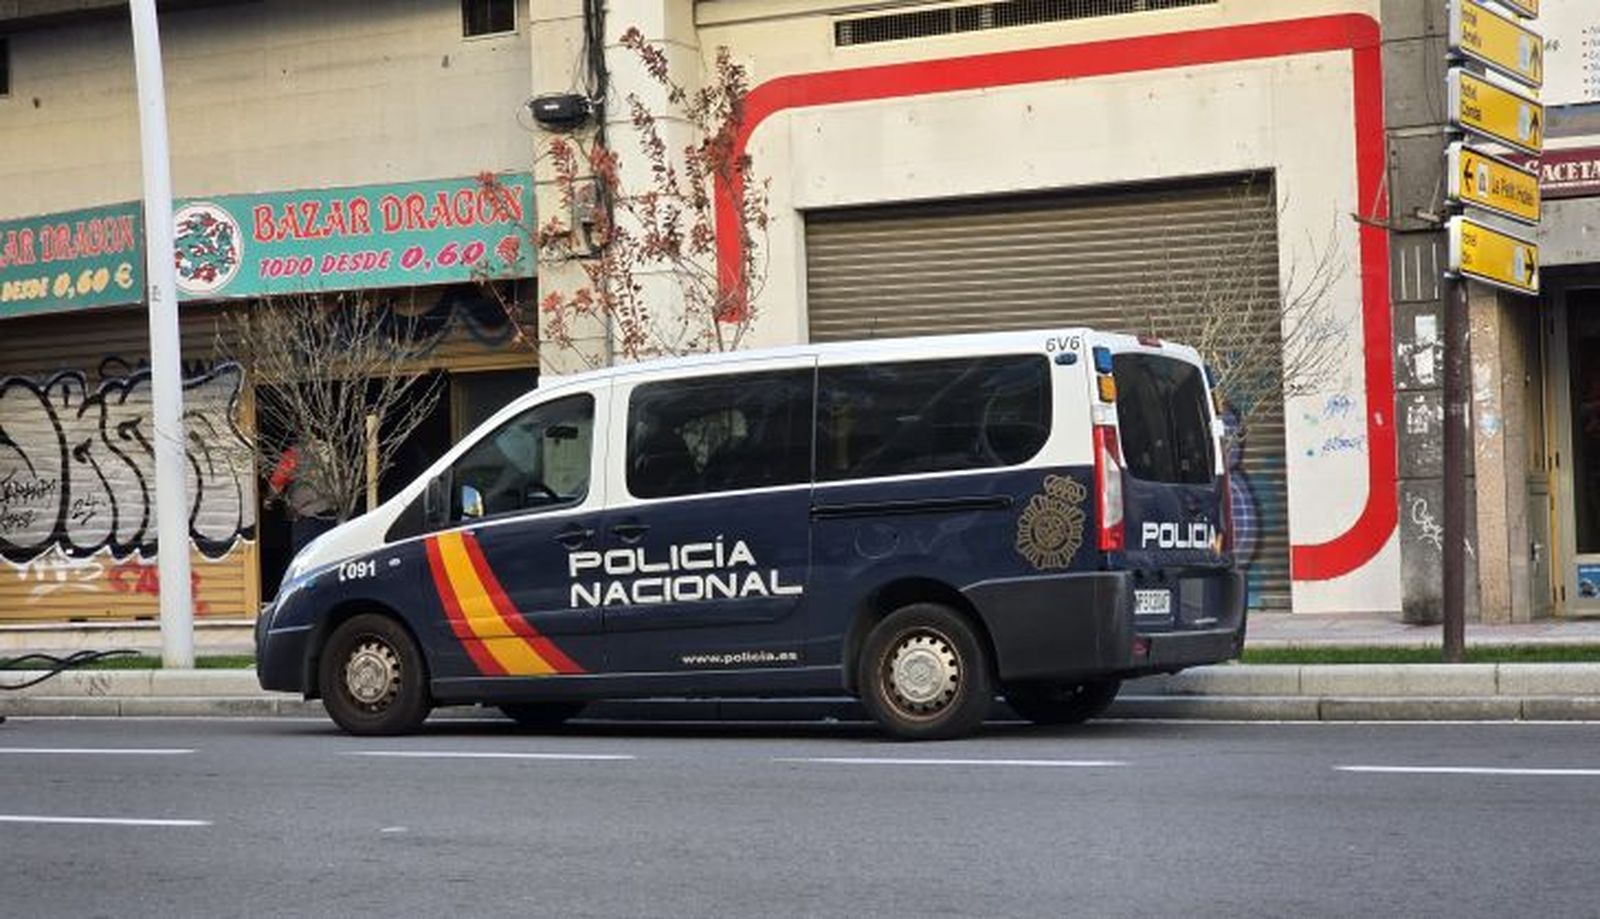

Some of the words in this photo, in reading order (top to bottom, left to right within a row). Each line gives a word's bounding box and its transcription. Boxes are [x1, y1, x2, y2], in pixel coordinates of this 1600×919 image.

[253, 196, 371, 243] BAZAR
[380, 184, 523, 234] DRAGON
[0, 228, 36, 267] AR
[259, 255, 313, 279] TODO
[320, 248, 392, 273] DESDE
[400, 239, 485, 272] 0,60
[53, 267, 111, 300] 0,60
[114, 261, 134, 290] €
[1045, 334, 1080, 353] 6V6
[346, 559, 376, 580] 091
[568, 534, 757, 577] POLICÍA
[570, 568, 804, 608] NACIONAL
[682, 649, 798, 665] www.policia.es
